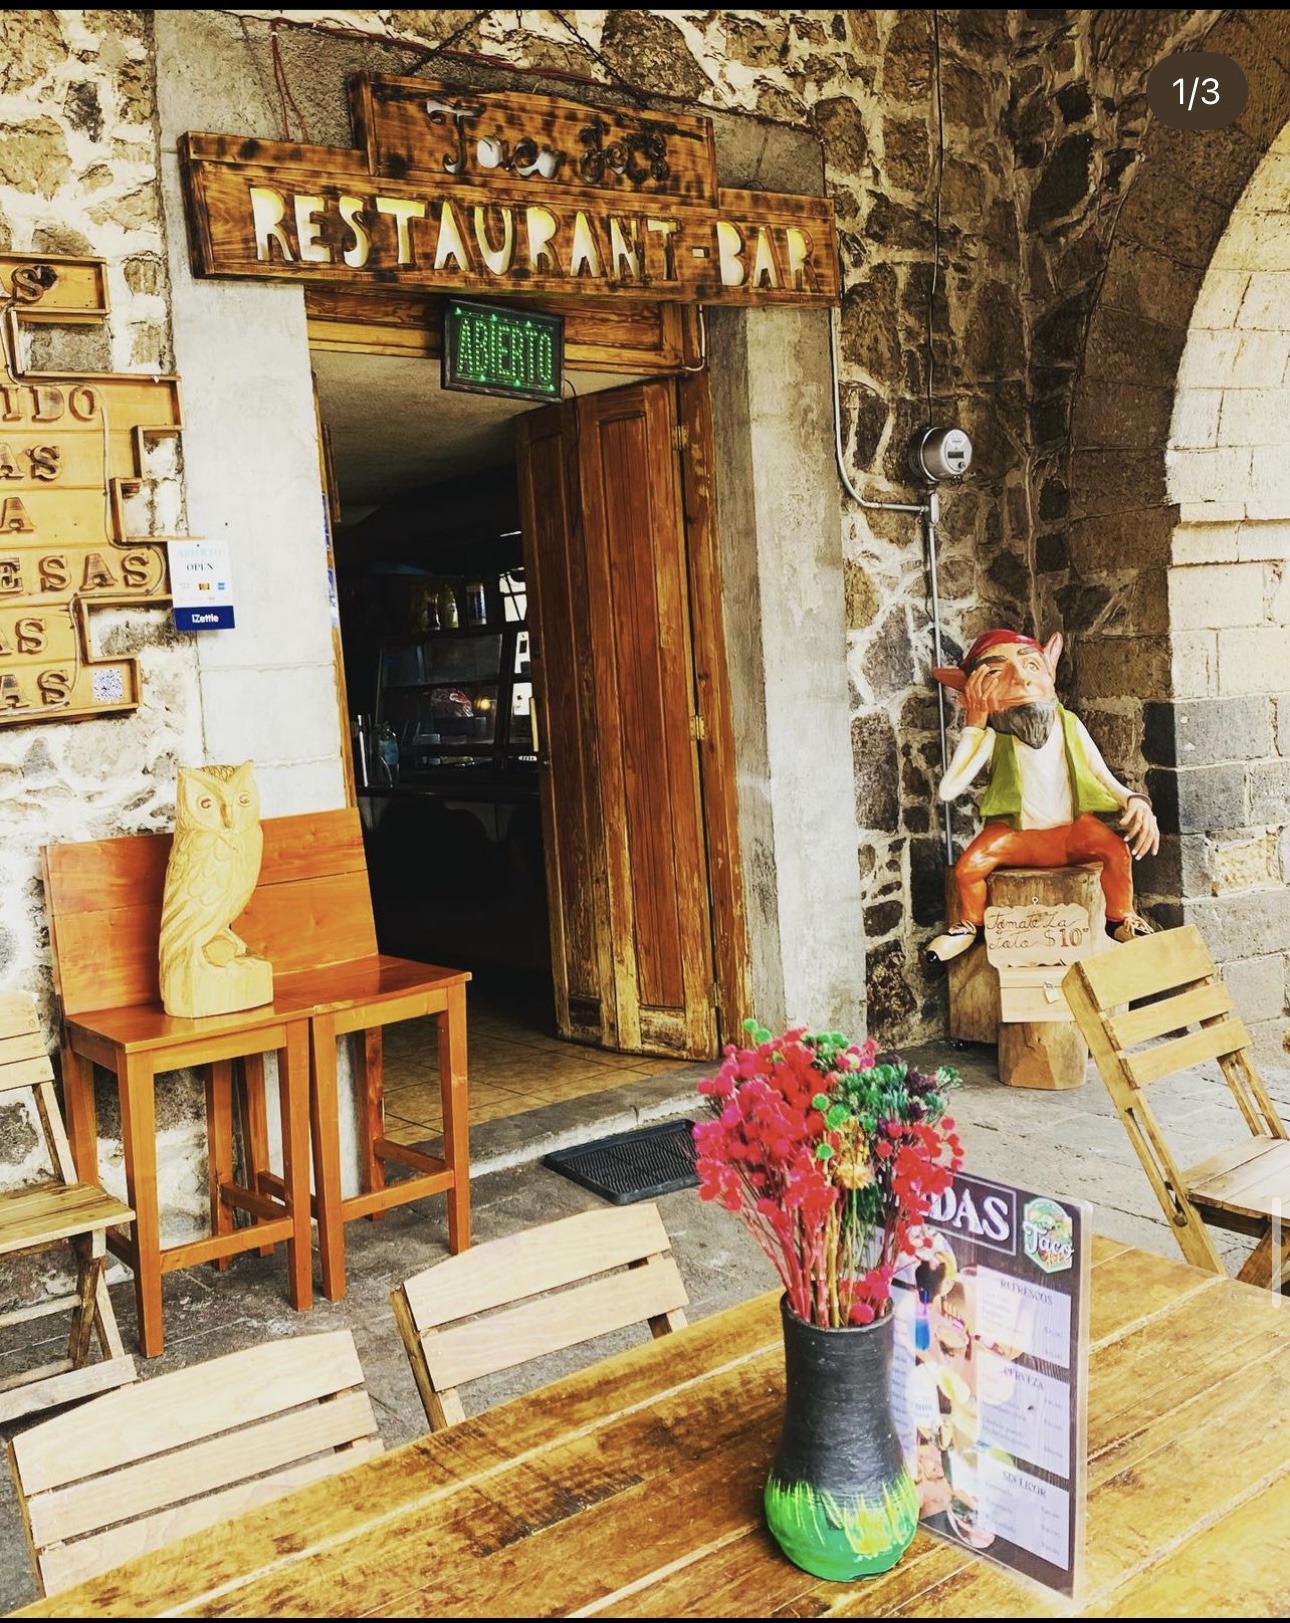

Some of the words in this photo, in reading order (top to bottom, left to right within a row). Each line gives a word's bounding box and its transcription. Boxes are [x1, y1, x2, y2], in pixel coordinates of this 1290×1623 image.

[457, 317, 553, 384] ABIERTO
[186, 562, 214, 571] OPEN
[1000, 1280, 1053, 1305] REFRESCOS
